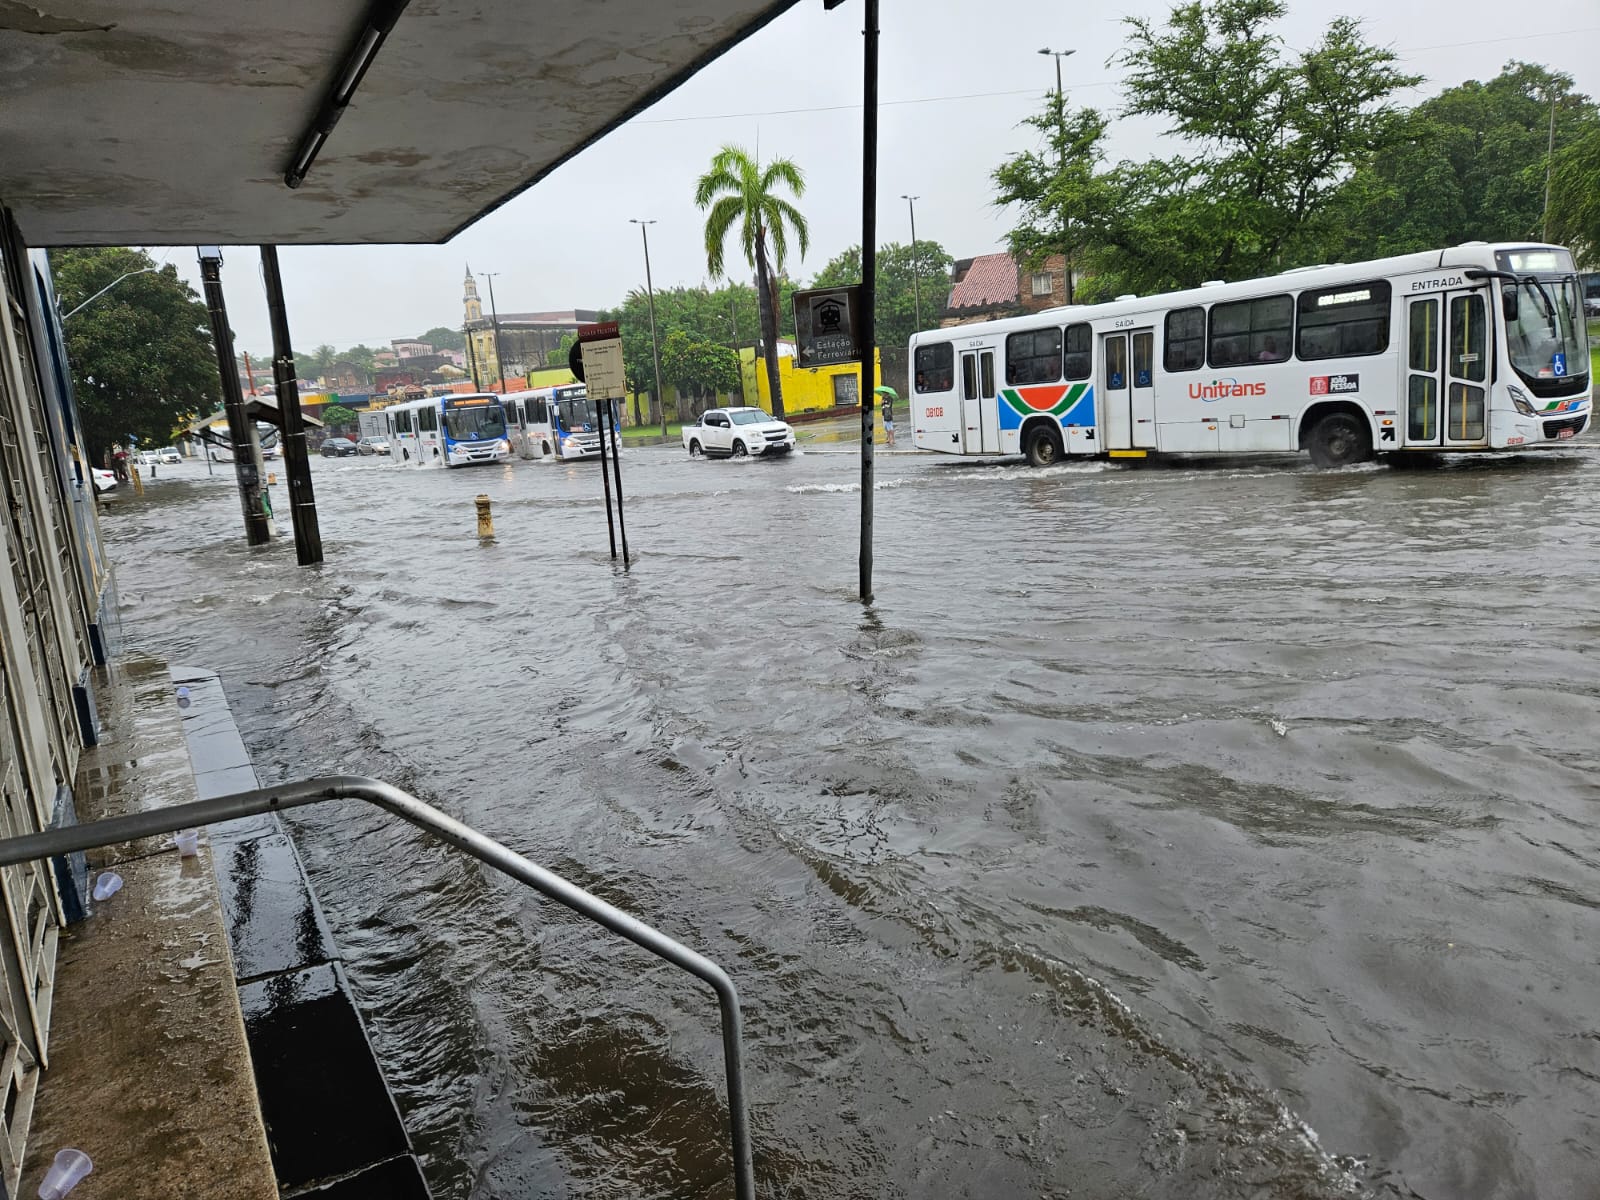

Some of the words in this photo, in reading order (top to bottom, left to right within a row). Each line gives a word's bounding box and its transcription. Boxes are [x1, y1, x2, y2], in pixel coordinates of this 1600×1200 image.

[1411, 276, 1463, 291] ENTRADA
[816, 338, 851, 350] Estação
[1189, 380, 1266, 399] Unitrans
